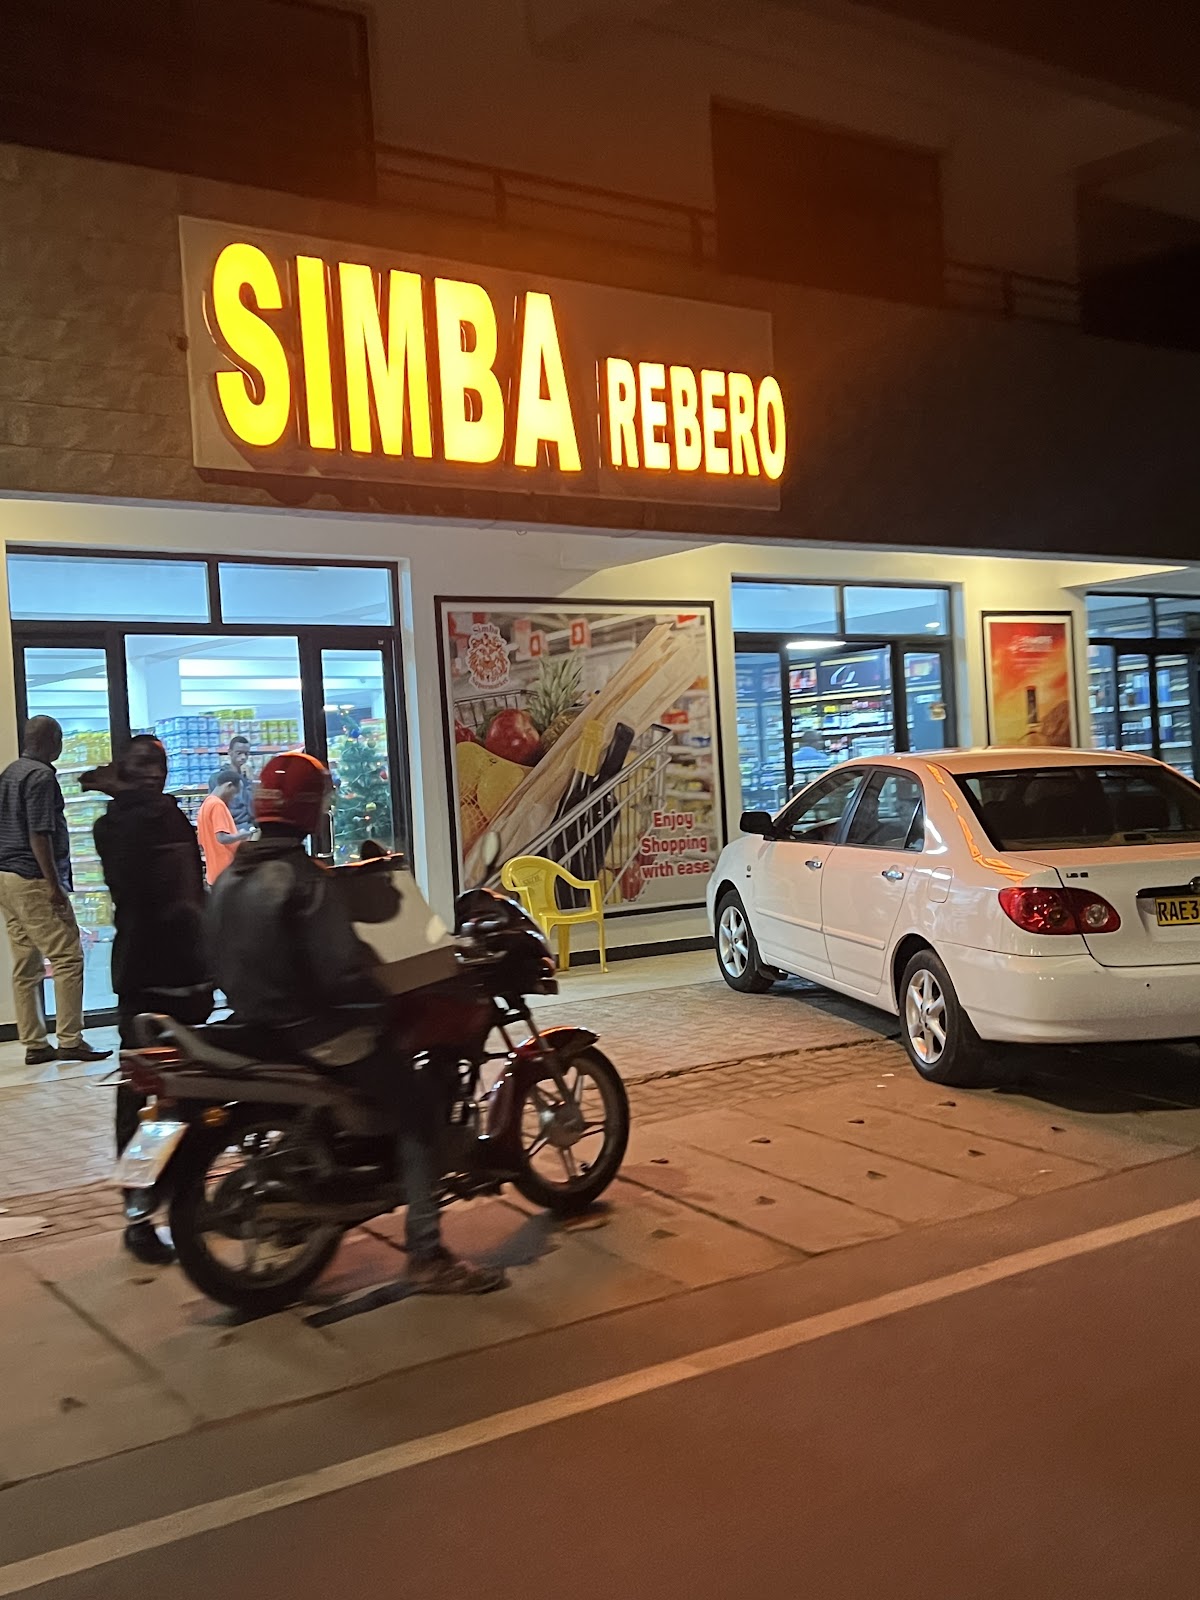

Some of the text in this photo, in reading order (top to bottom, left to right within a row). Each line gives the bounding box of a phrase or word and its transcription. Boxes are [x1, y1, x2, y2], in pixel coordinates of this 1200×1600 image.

[212, 242, 788, 481] SIMBA REBERO
[653, 810, 693, 830] Enjoy
[641, 834, 707, 855] Shopping
[642, 861, 710, 879] with ease
[1157, 900, 1200, 922] RAE3
